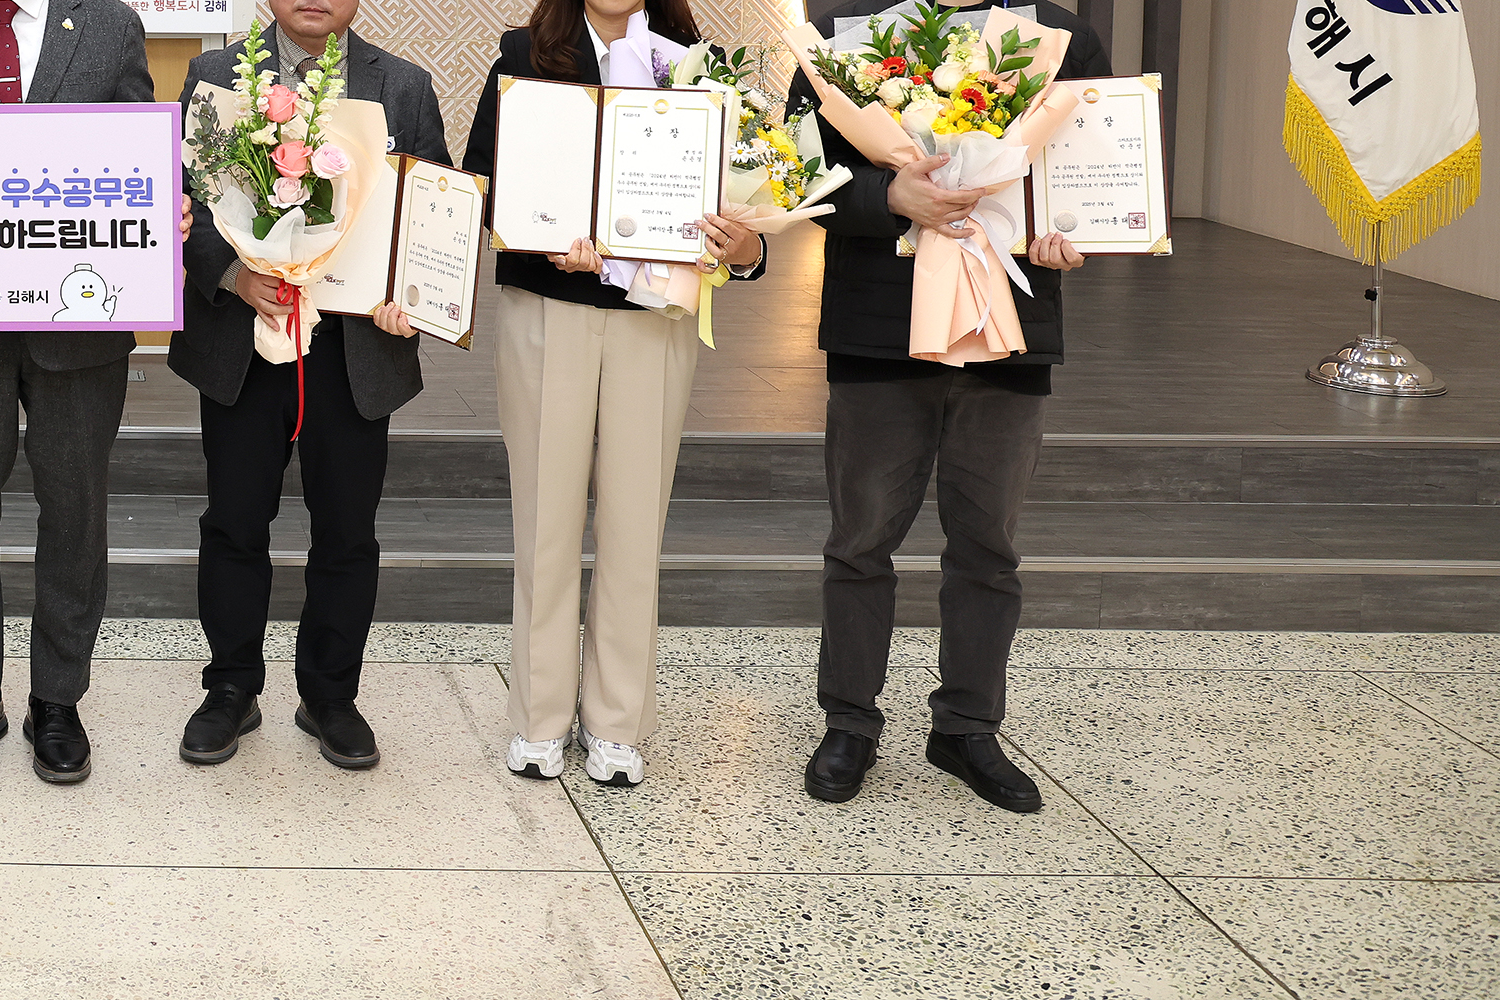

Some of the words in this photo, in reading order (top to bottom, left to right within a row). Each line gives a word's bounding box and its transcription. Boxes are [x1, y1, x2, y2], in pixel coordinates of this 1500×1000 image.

[153, 0, 200, 12] 행복도시
[204, 0, 227, 13] 김해
[2, 175, 154, 208] 우수공무원
[7, 290, 49, 304] 김해시
